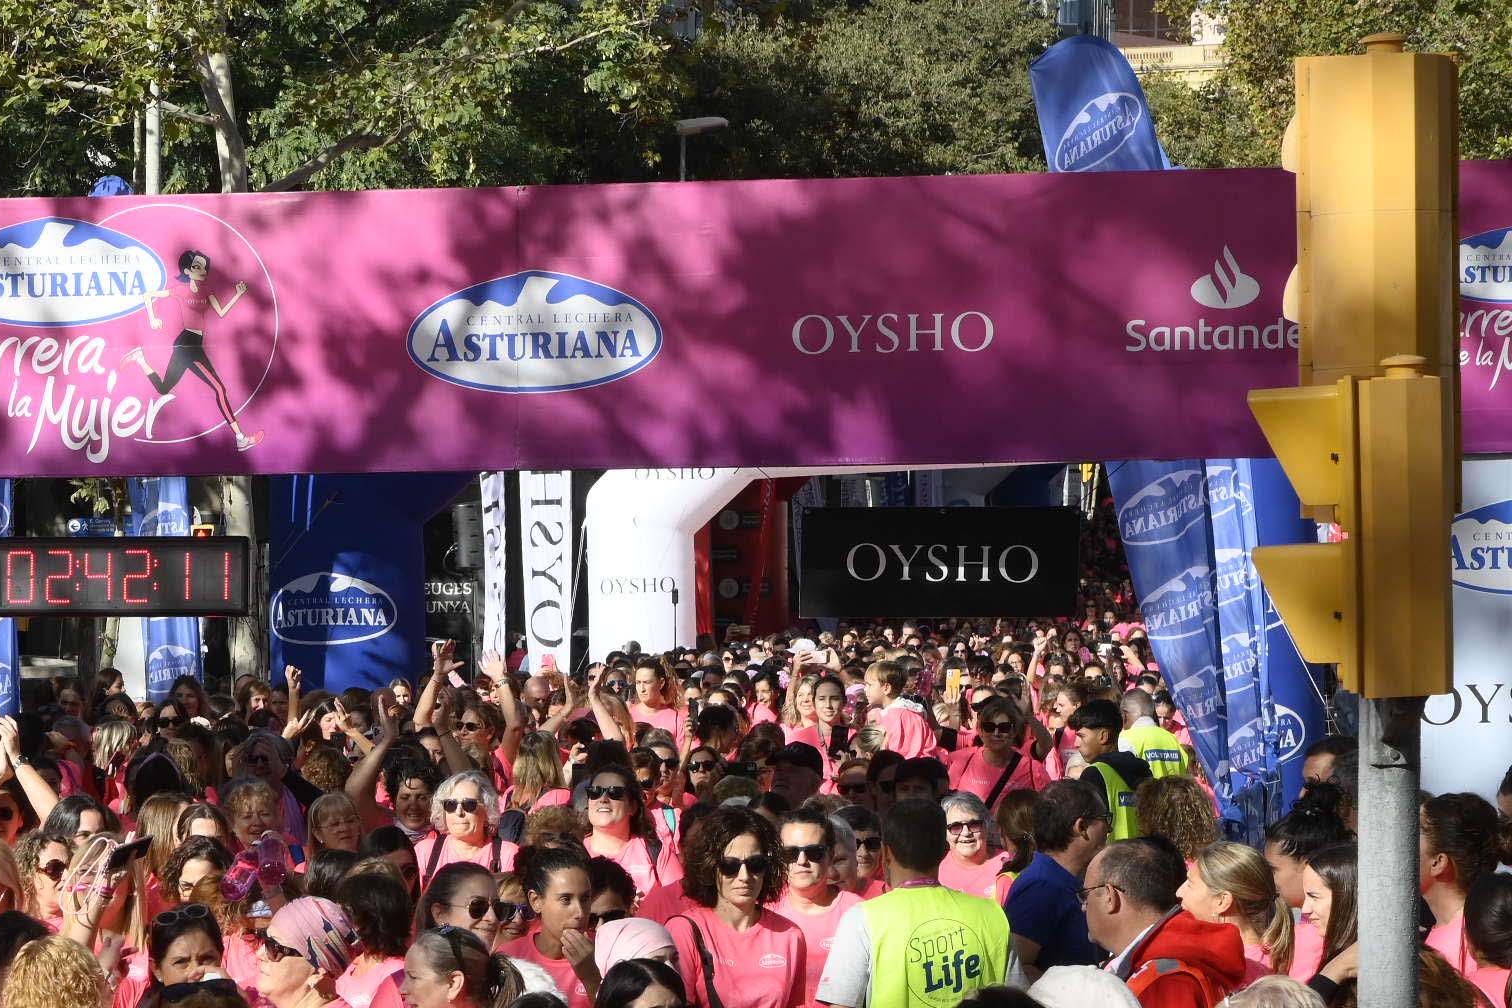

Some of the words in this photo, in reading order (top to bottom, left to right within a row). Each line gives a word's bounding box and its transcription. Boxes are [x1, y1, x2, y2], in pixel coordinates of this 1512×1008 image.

[72, 254, 142, 265] LECHERA
[466, 313, 546, 326] CENTRAL
[553, 312, 634, 324] LECHERA
[791, 311, 995, 354] OYSHO
[426, 318, 642, 362] ASTURIANA
[6, 378, 32, 418] la
[28, 368, 176, 463] Mujer
[7, 549, 230, 604] 02:42:11
[846, 542, 1041, 583] OYSHO
[600, 575, 676, 596] OYSHO
[275, 601, 389, 629] ASTURIANA
[909, 926, 968, 963] Sport
[923, 949, 981, 993] Life
